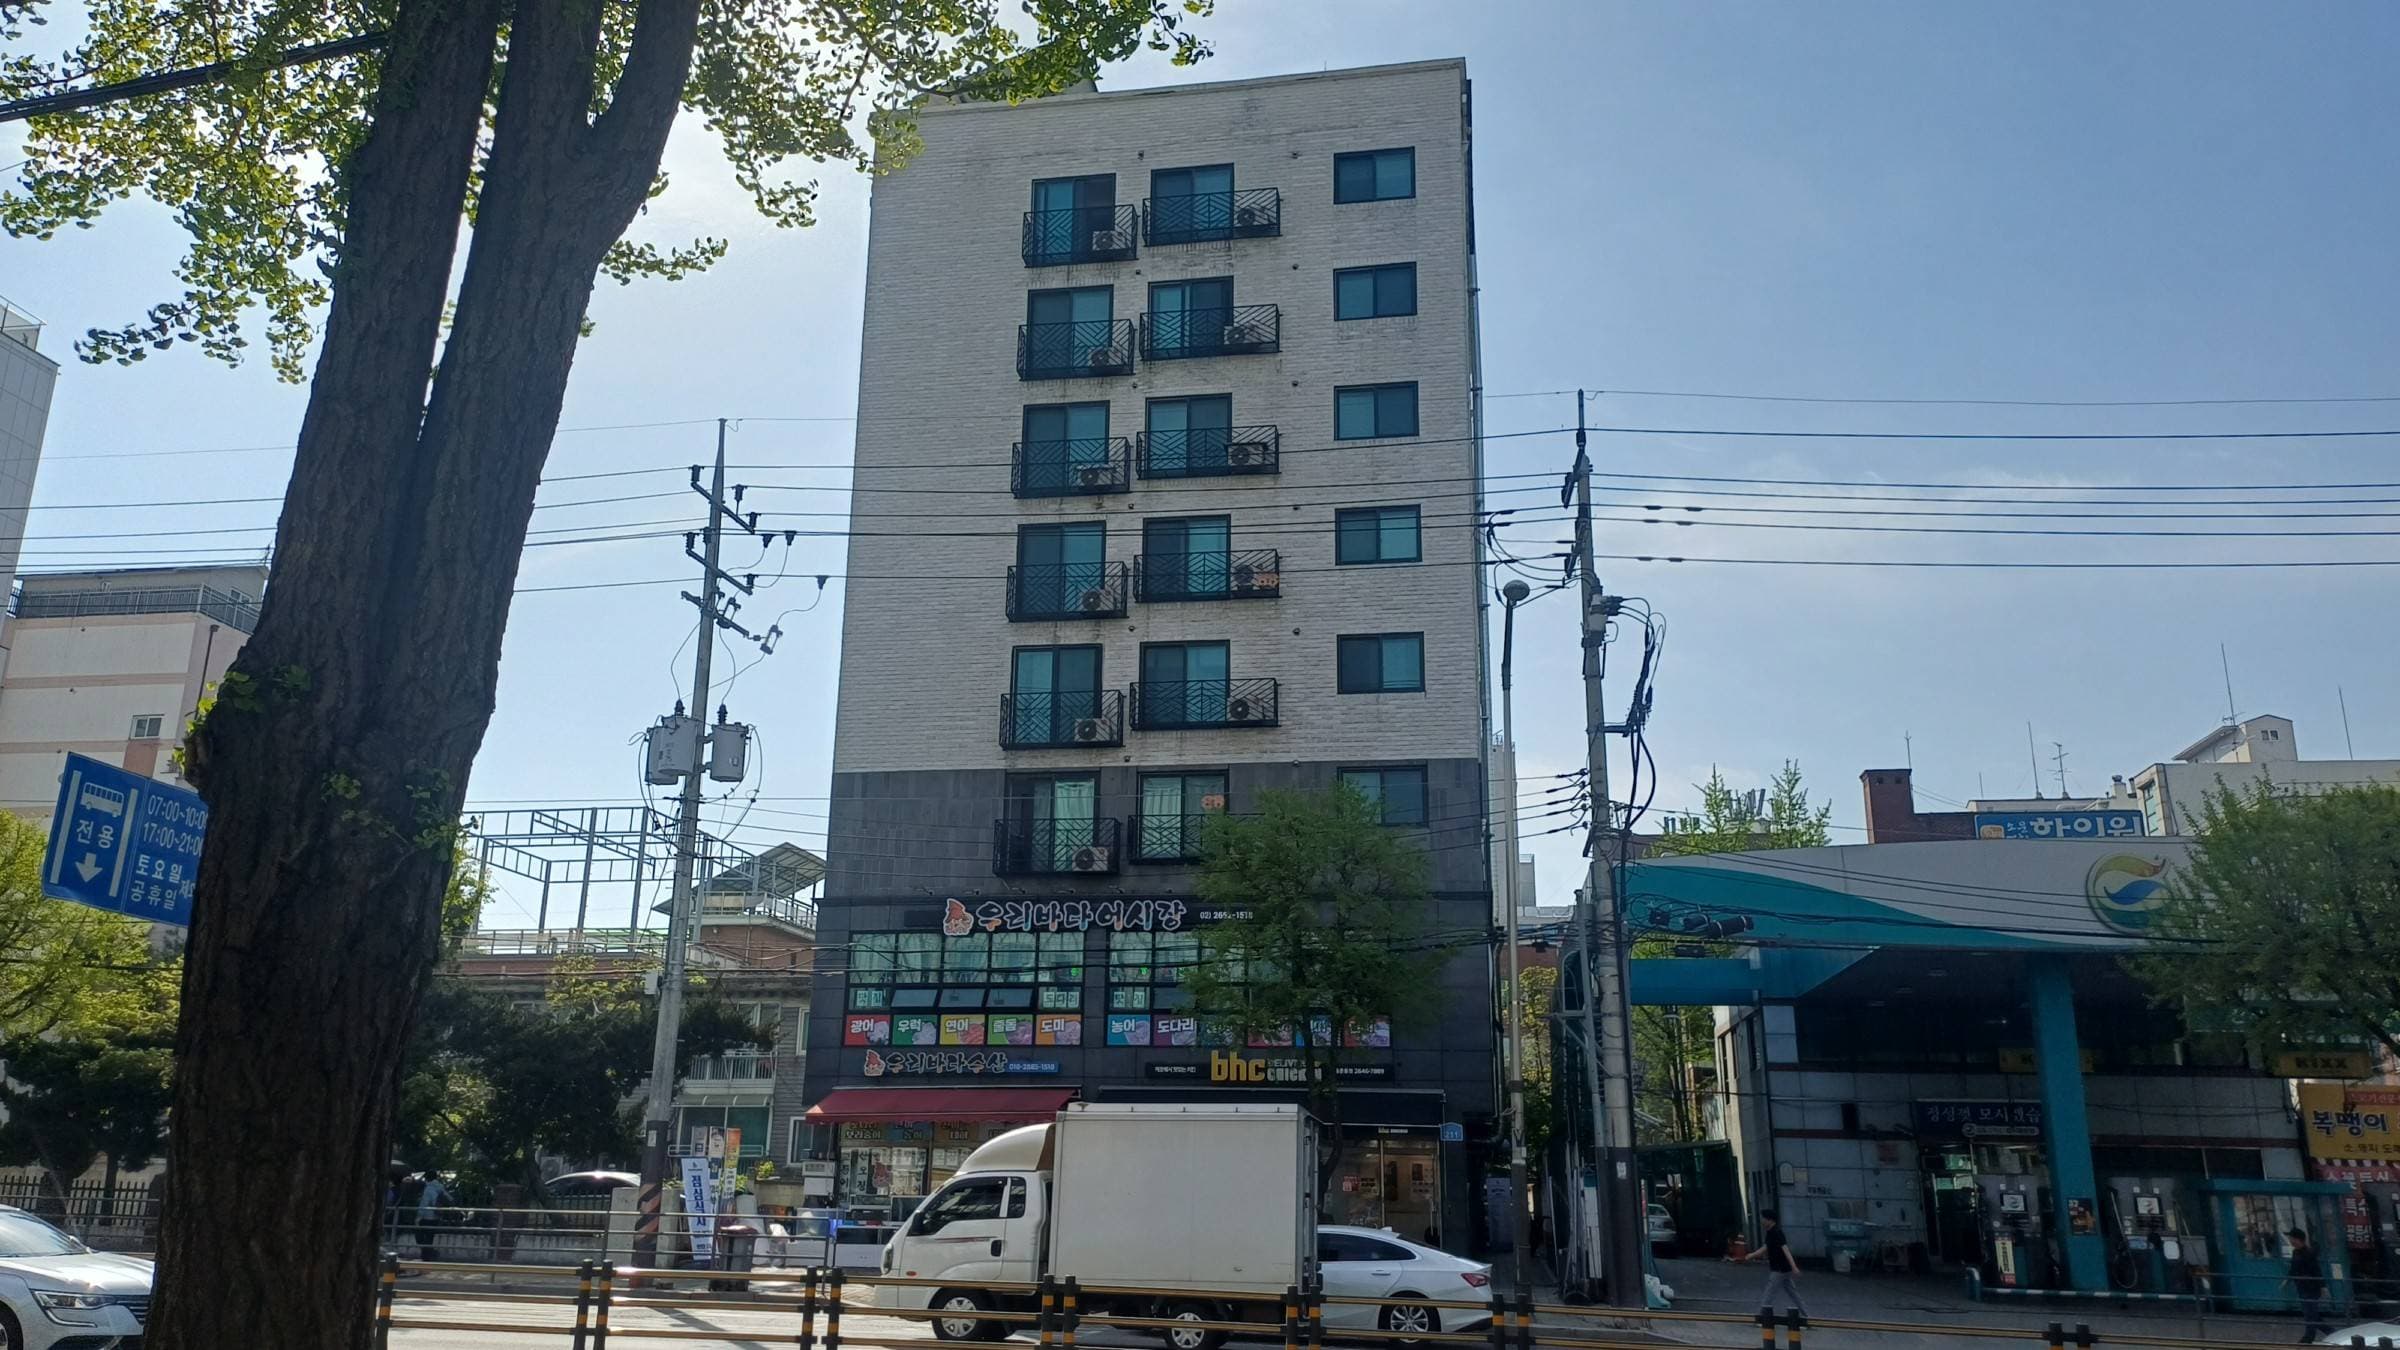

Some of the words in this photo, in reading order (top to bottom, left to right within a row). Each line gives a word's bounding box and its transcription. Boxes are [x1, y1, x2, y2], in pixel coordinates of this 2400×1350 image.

[76, 819, 114, 849] 전용
[136, 854, 183, 884] 토요일
[130, 880, 178, 910] 공휴일
[976, 900, 1187, 931] 우리바다어시장
[851, 1018, 875, 1033] 광어
[945, 1018, 969, 1033] 연어
[1041, 1018, 1065, 1033] 도미
[1111, 1018, 1136, 1033] 농어
[1157, 1017, 1194, 1033] 도다리
[886, 1052, 1008, 1074] 우리바다수산
[1210, 1049, 1266, 1082] bhc
